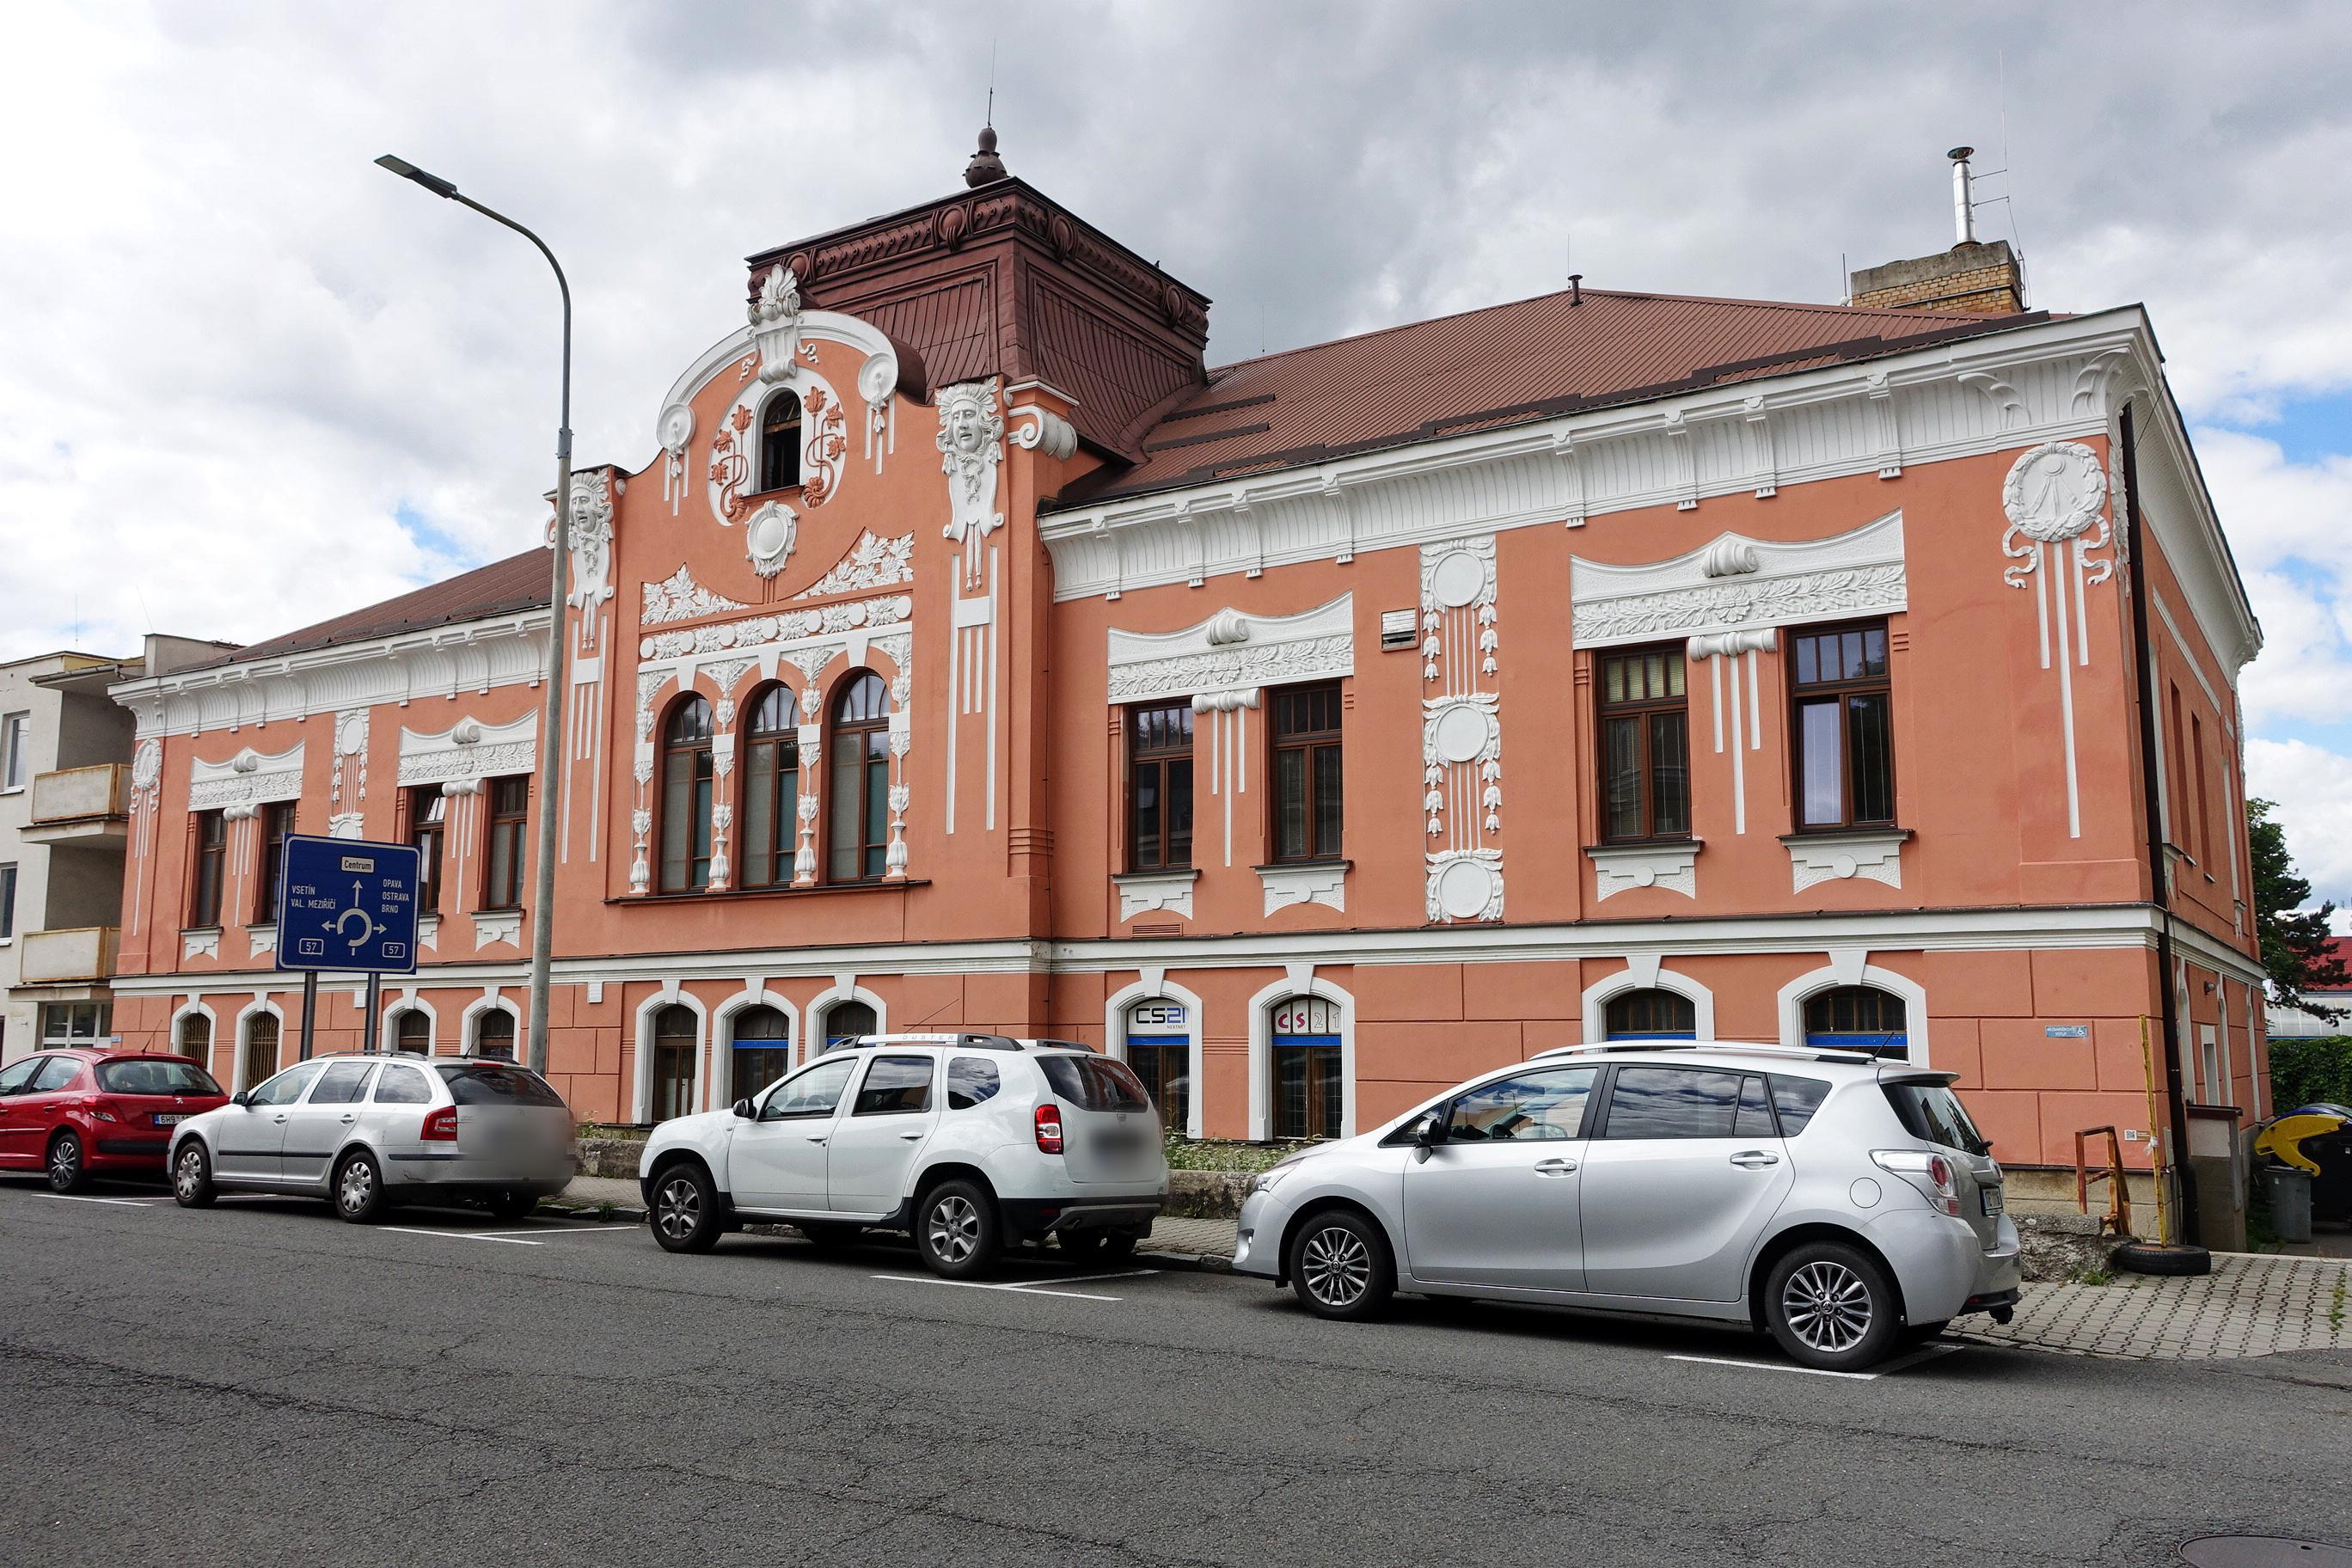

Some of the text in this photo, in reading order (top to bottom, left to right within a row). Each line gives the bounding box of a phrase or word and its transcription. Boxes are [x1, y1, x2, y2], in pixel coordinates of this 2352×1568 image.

[344, 861, 371, 870] Centrum
[383, 879, 402, 889] OPAVA
[291, 884, 315, 895] VSETÍN
[382, 891, 410, 902] OSTRAVA
[308, 897, 336, 910] MEZIŘÍČÍ
[381, 904, 399, 913] BRNO
[305, 942, 316, 952] 57
[389, 946, 399, 955] 57
[1136, 1008, 1185, 1024] CS21
[161, 1115, 176, 1124] 6H9
